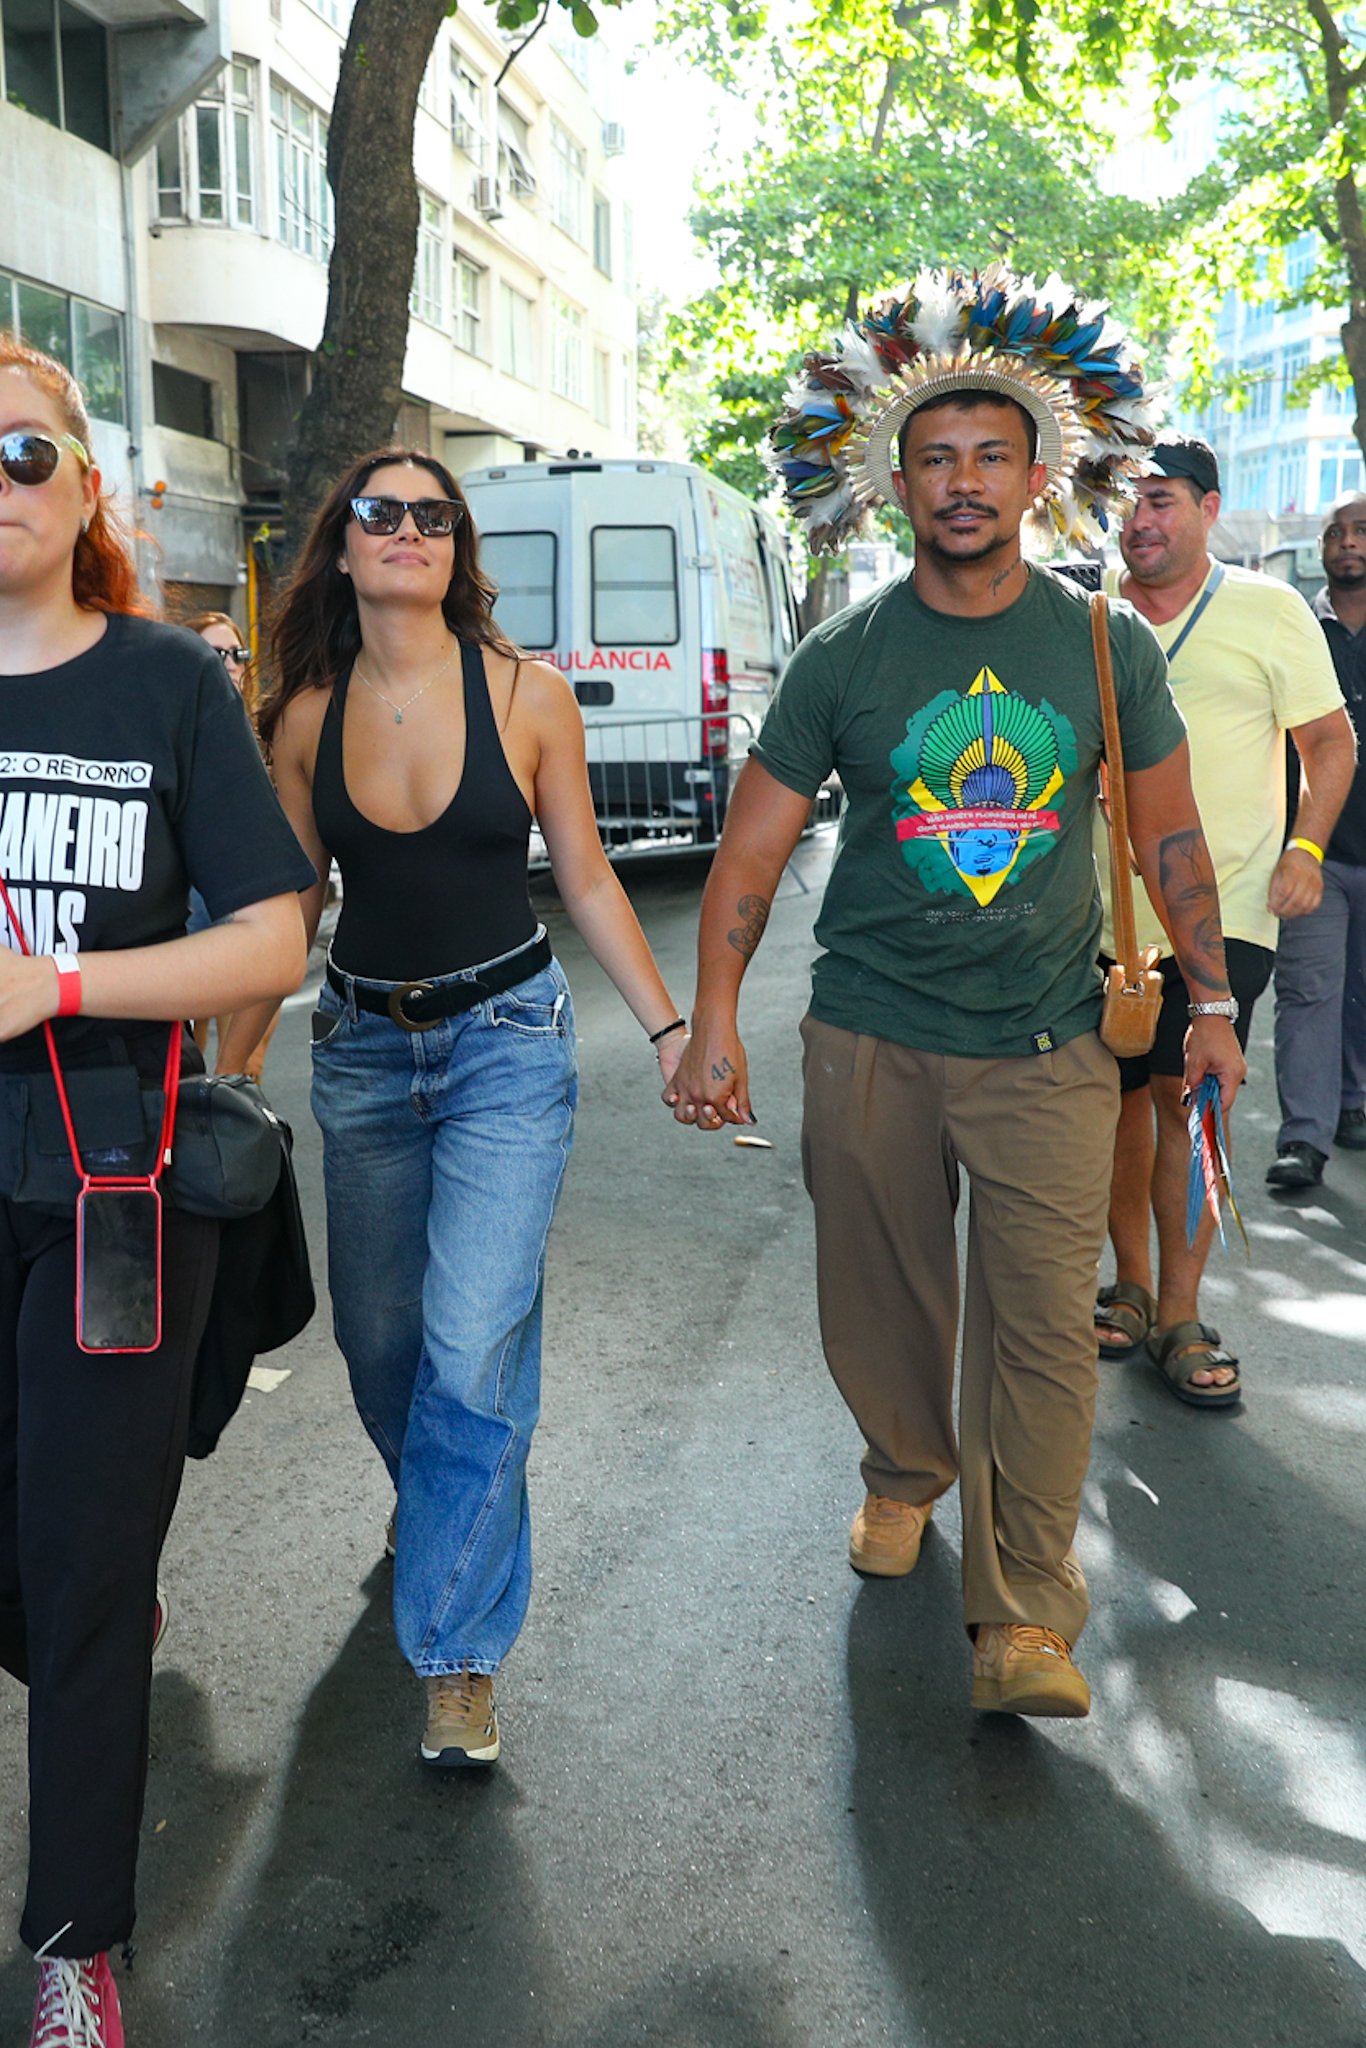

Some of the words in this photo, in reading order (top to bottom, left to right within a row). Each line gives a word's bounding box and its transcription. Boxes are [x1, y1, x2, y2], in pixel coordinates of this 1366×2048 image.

[23, 757, 41, 773] O
[46, 759, 147, 783] RETORNO
[0, 791, 149, 891] ANEIRO
